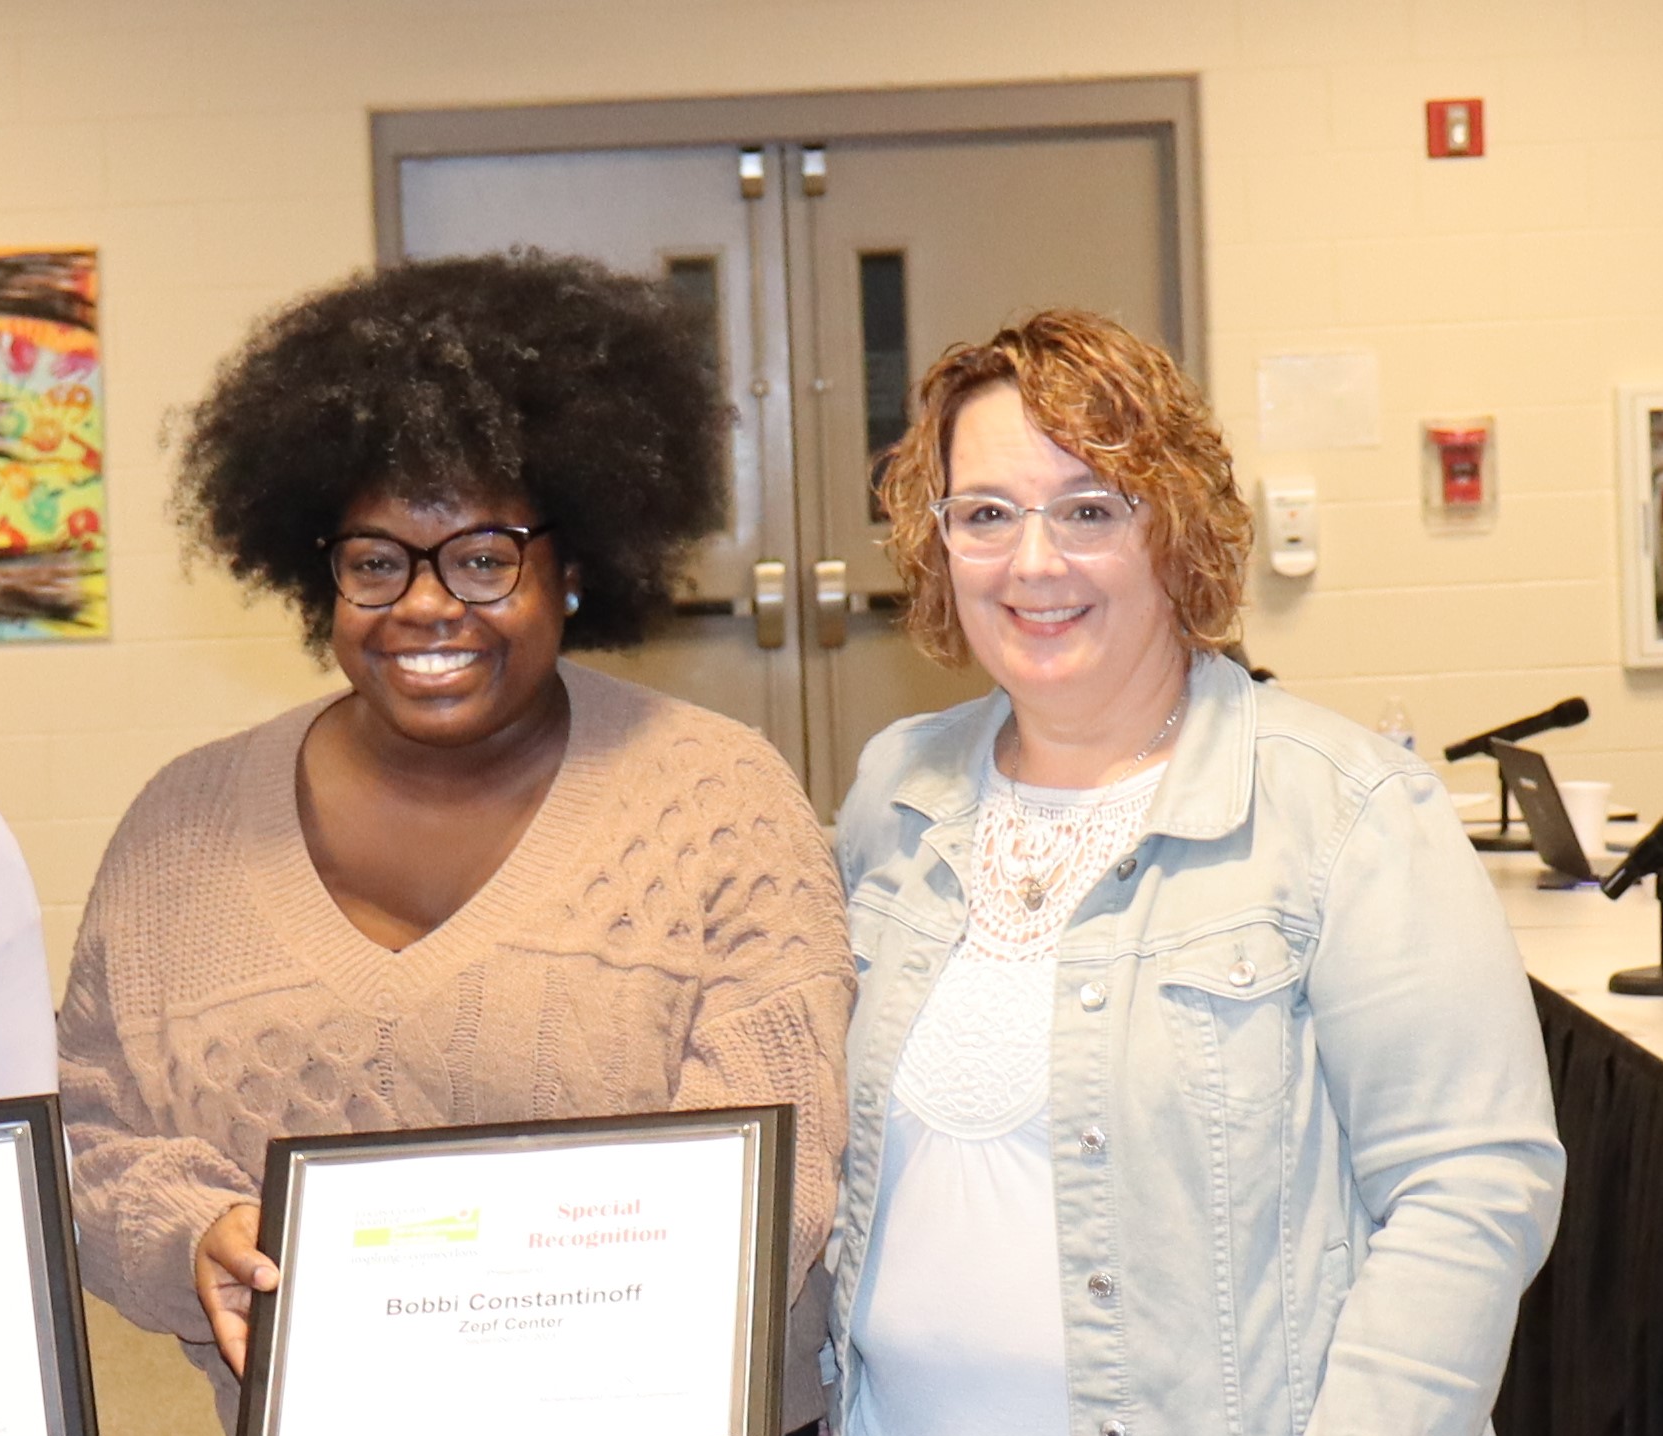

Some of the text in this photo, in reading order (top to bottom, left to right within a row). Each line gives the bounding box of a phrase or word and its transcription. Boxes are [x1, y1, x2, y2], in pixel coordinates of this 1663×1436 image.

[557, 1199, 641, 1222] Special
[528, 1226, 667, 1249] Recognition
[386, 1283, 643, 1315] Bobbi Constantinoff
[459, 1316, 564, 1334] Zepf Center
